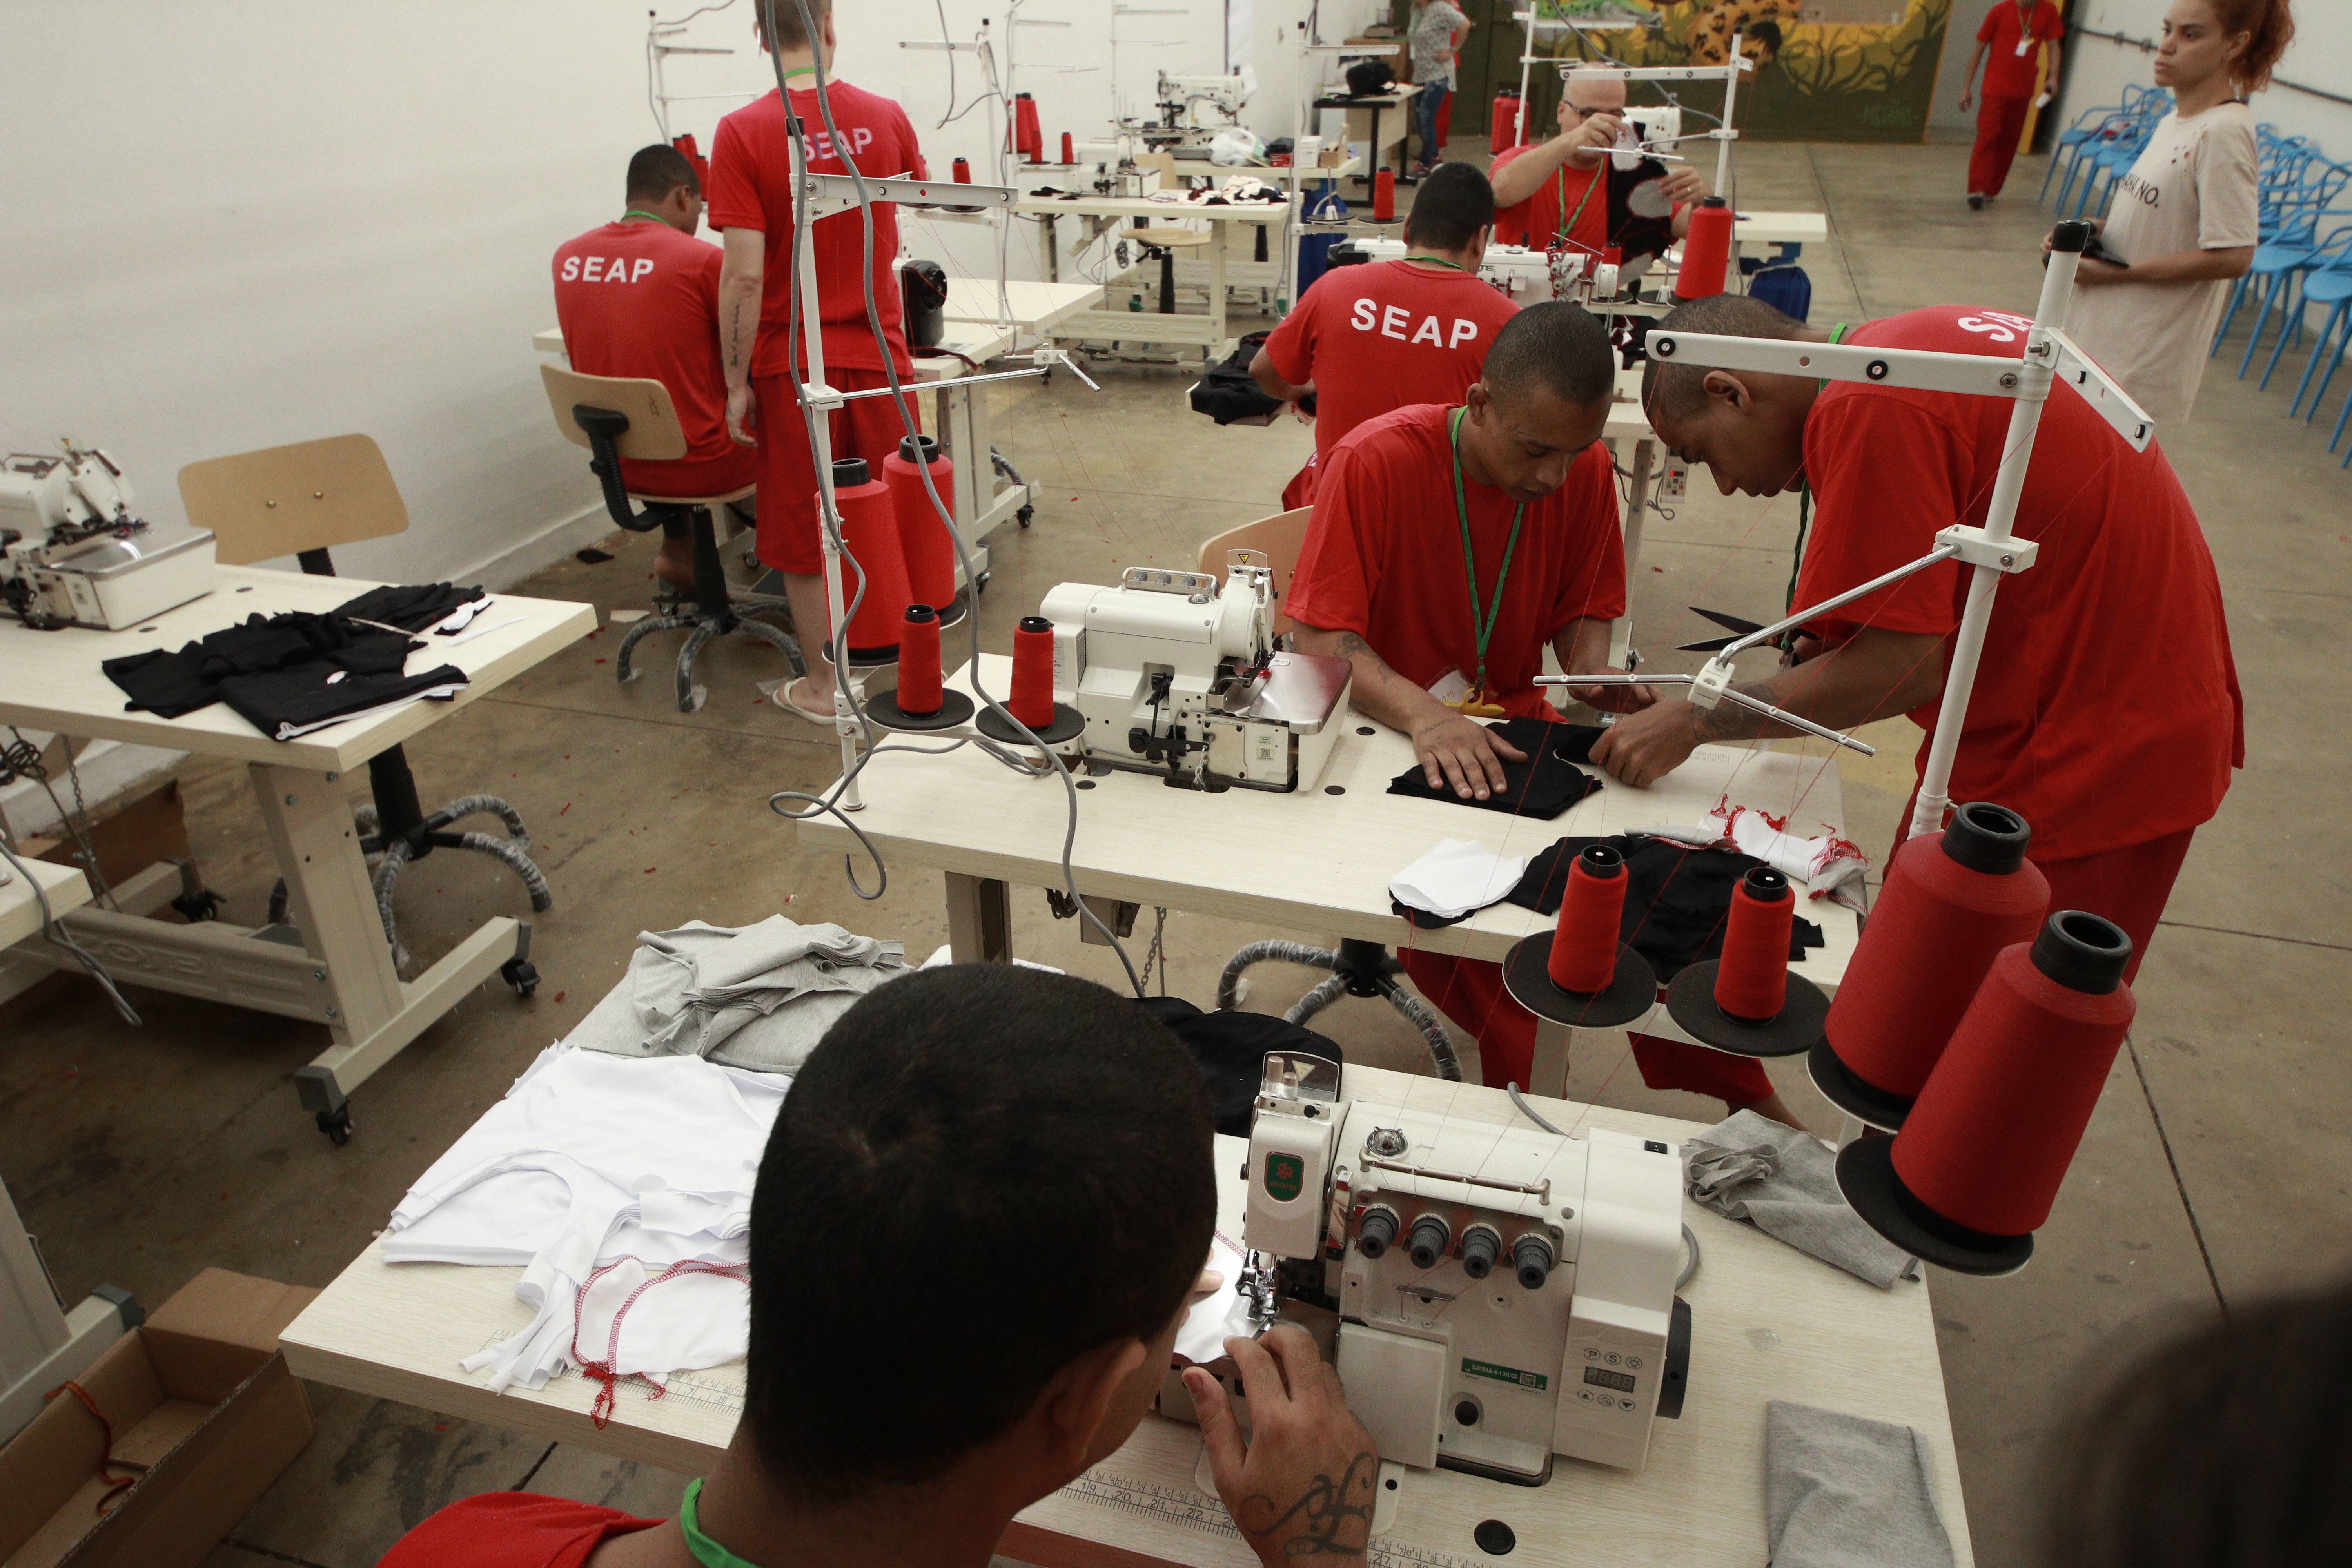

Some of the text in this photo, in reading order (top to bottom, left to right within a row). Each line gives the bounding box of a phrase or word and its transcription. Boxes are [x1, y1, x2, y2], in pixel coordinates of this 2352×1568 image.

[804, 128, 873, 162] SEAP
[2134, 180, 2158, 208] NO.
[561, 256, 654, 283] SEAP
[1351, 298, 1478, 349] SEAP
[1609, 1354, 1617, 1363] S
[717, 1395, 725, 1403] 8
[1082, 1483, 1096, 1493] 19
[1114, 1491, 1131, 1502] 20
[1150, 1499, 1165, 1510] 21
[1187, 1508, 1203, 1519] 22
[1373, 1553, 1391, 1565] 27
